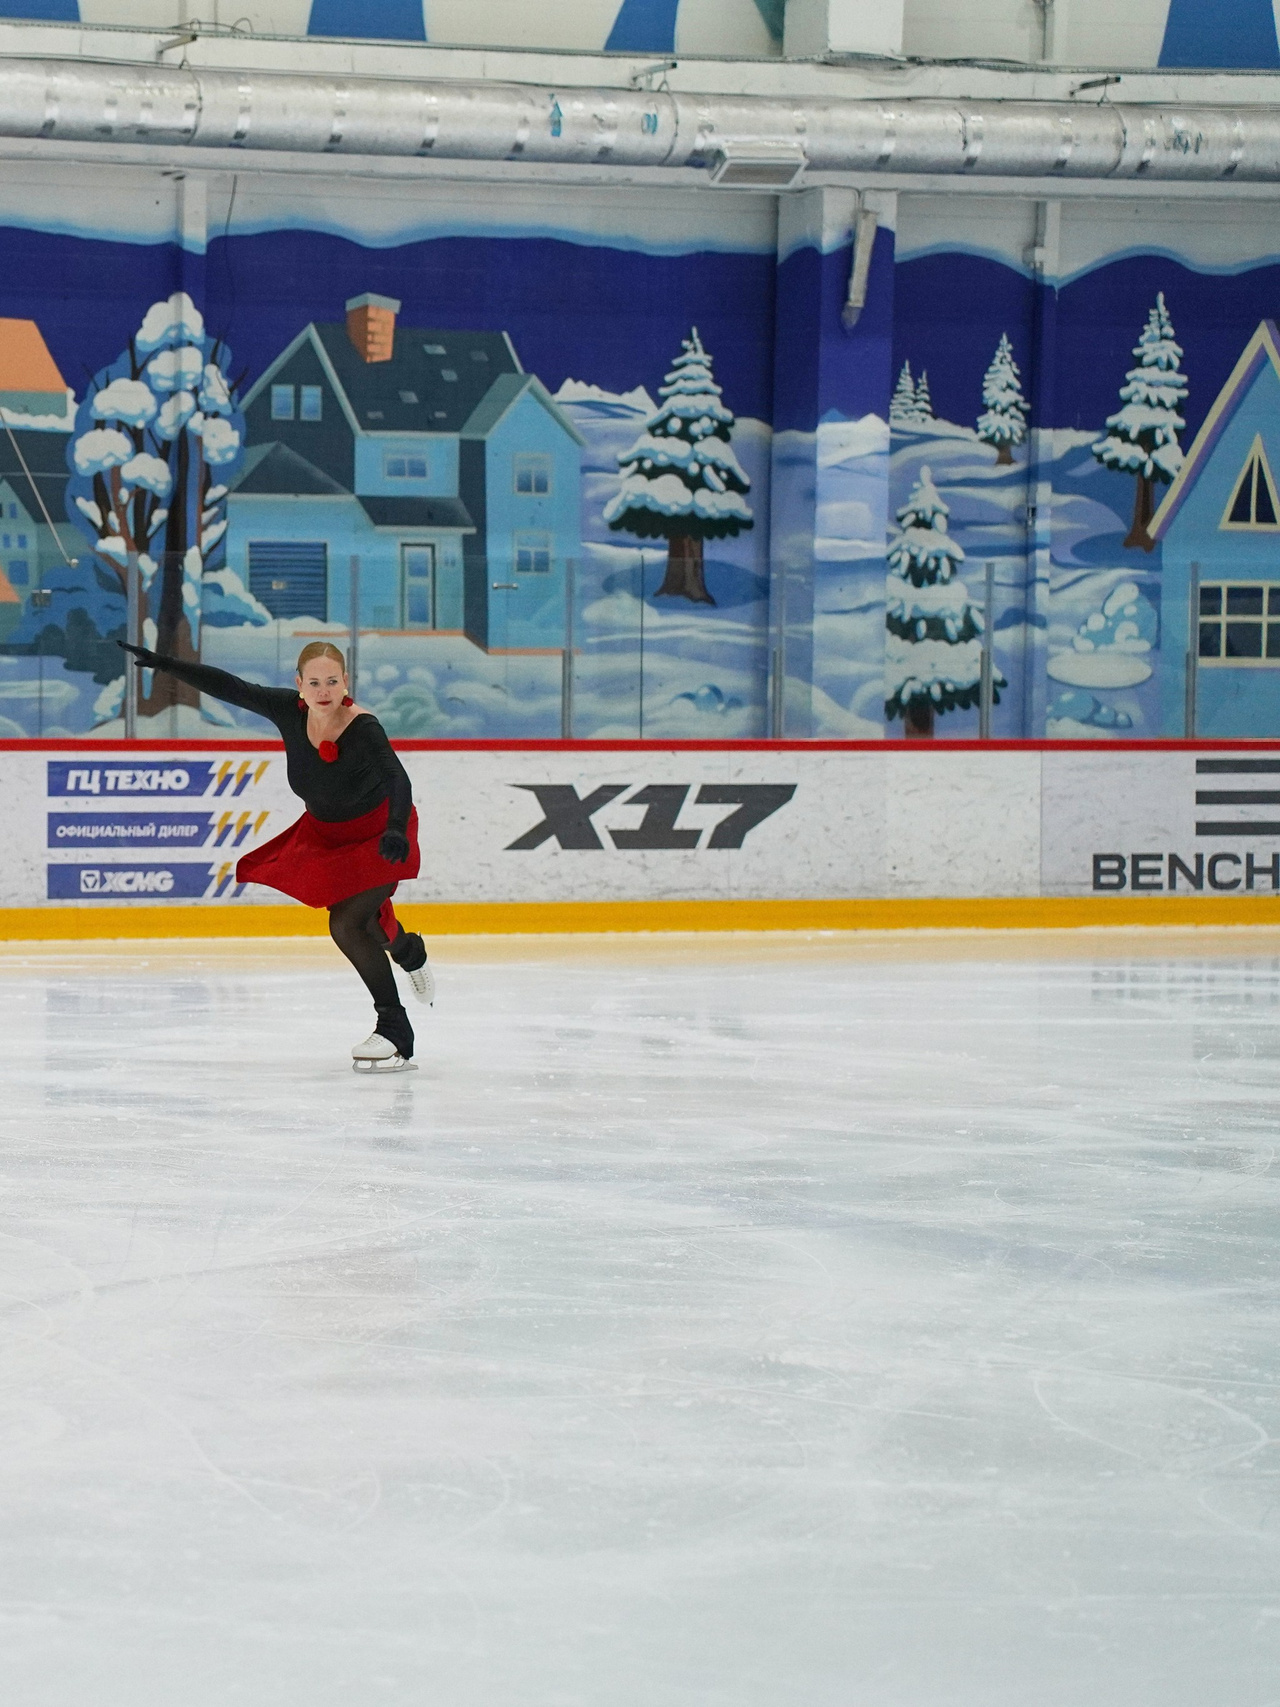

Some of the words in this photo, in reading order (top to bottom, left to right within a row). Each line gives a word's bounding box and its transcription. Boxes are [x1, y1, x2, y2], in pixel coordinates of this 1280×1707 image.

[66, 769, 101, 794] ГЦ
[104, 769, 190, 791] ТЕХНО
[502, 784, 798, 850] X17
[56, 822, 156, 839] ОФИЦИАЛЬНЫЙ
[157, 825, 199, 839] ДИЛЕР
[99, 871, 174, 892] XCMG
